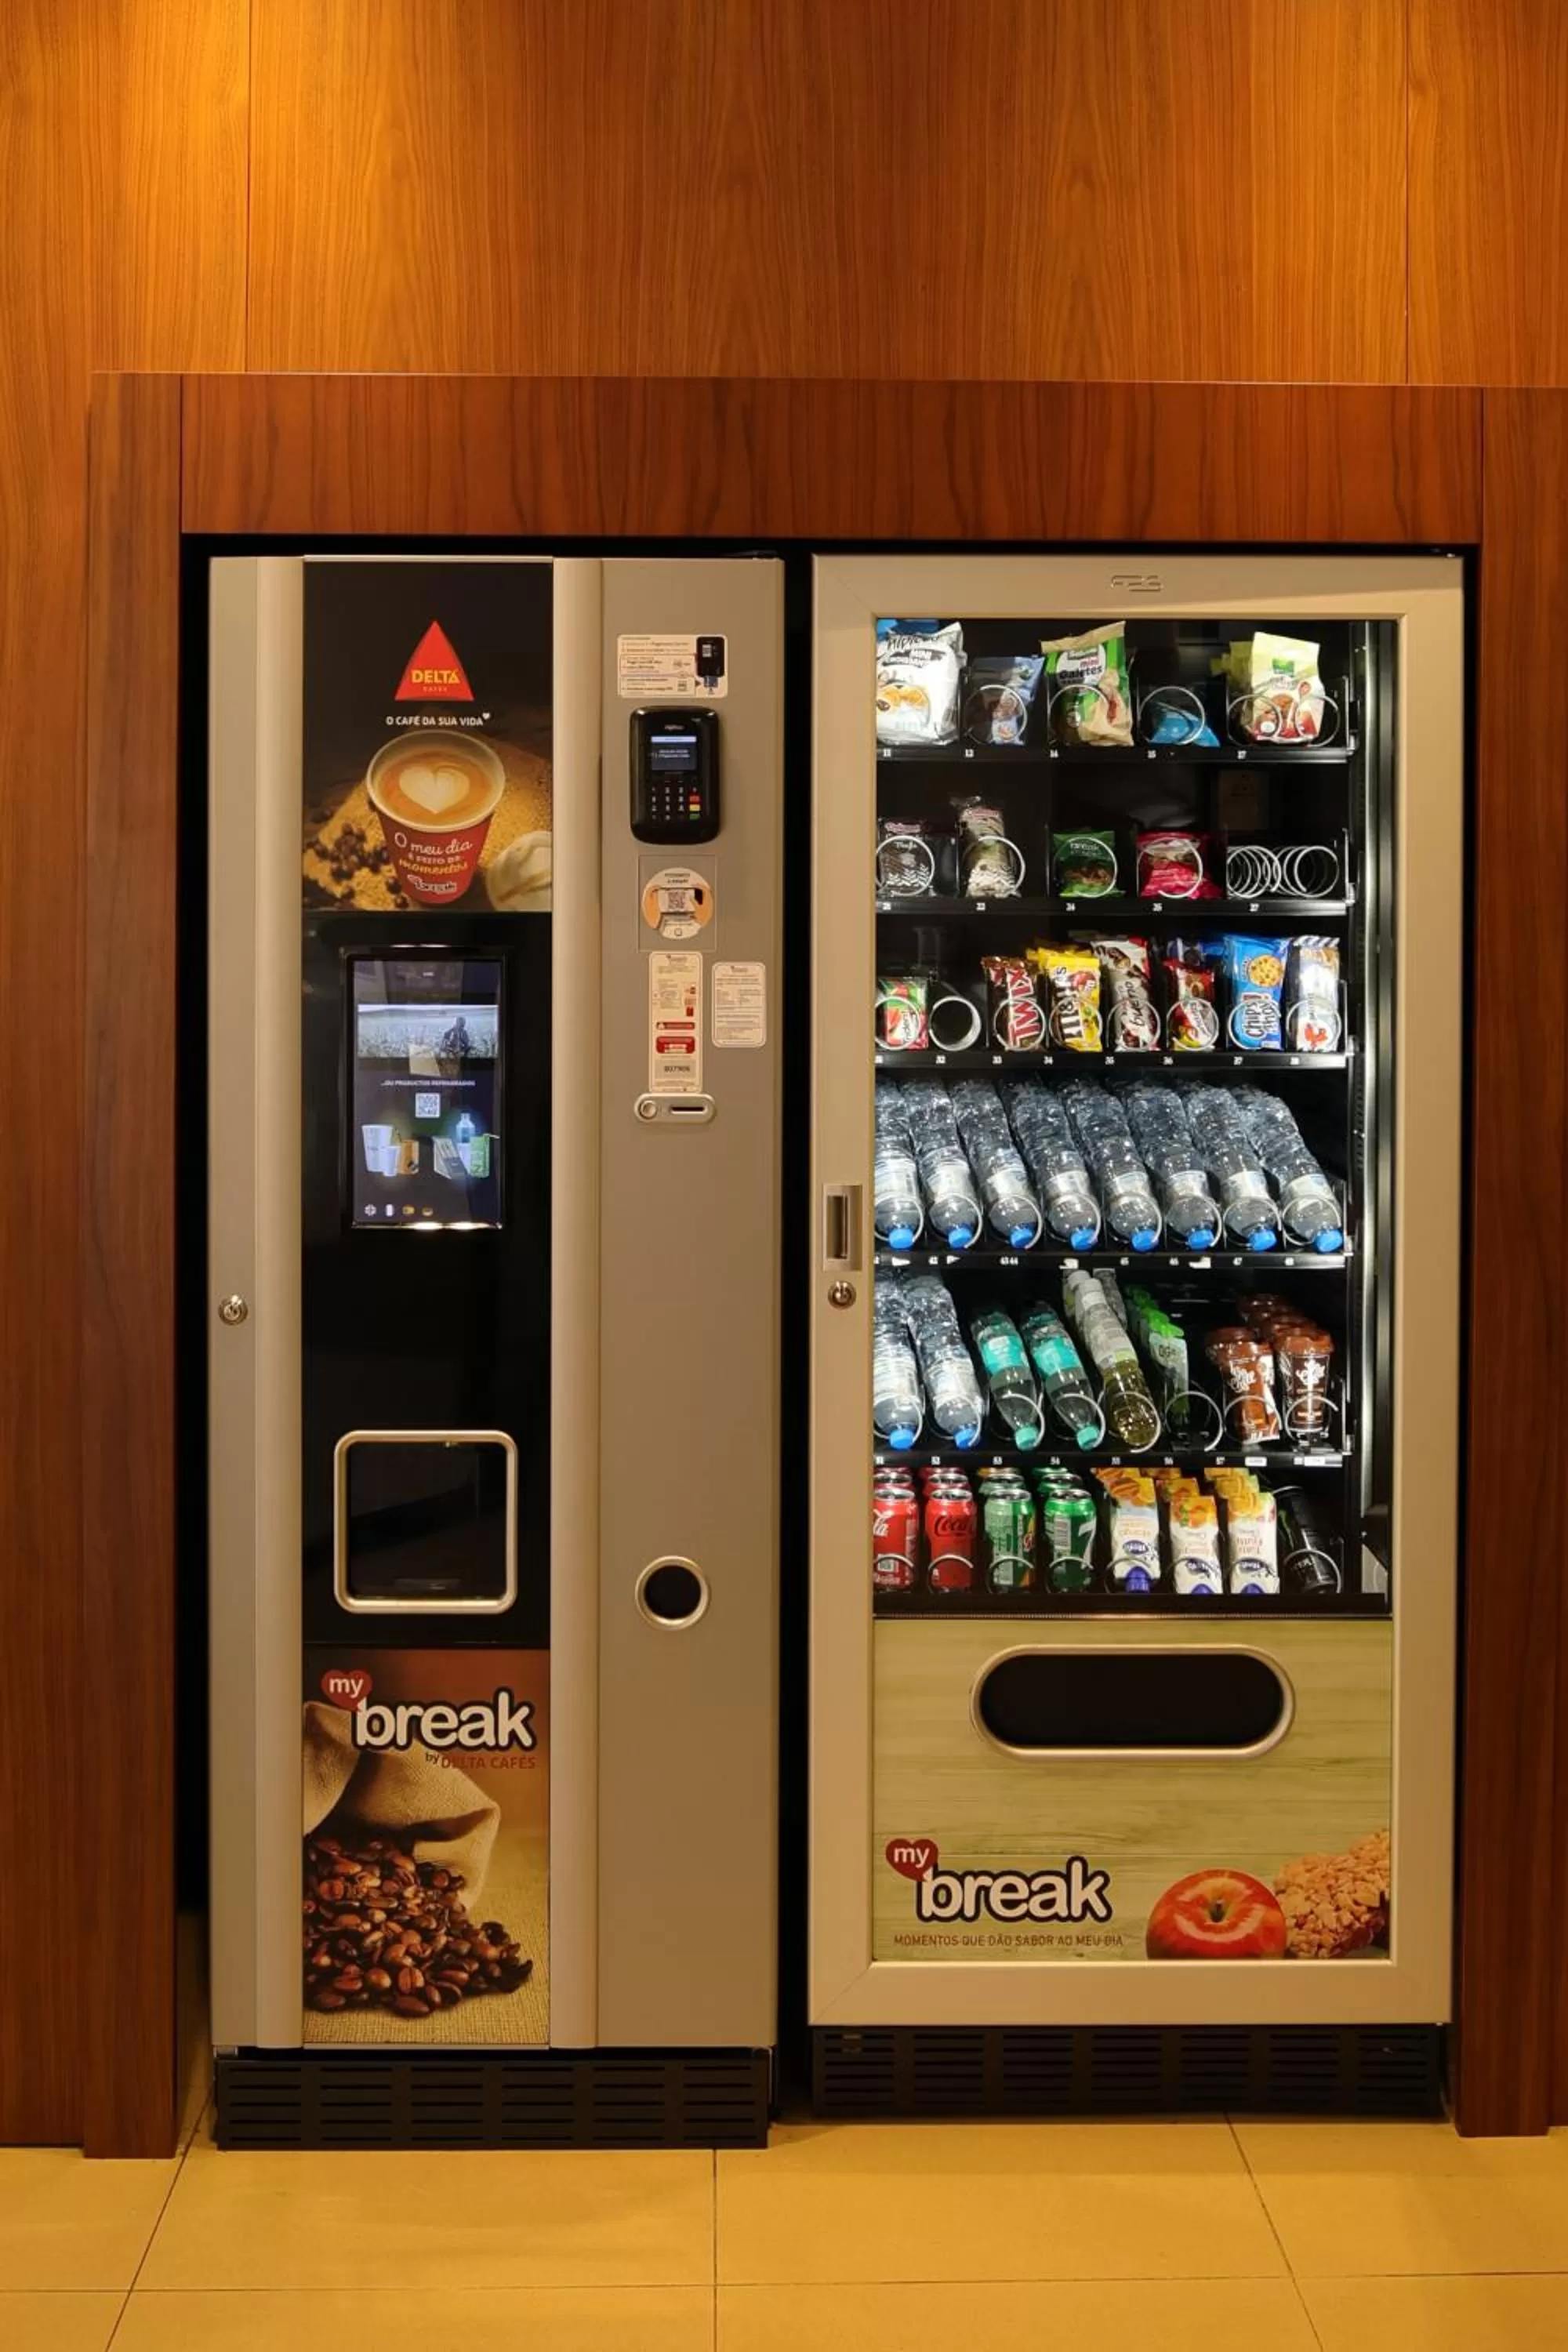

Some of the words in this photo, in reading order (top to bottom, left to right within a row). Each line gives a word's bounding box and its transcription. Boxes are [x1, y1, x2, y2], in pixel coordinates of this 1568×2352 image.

[412, 670, 460, 684] DELTA
[387, 717, 394, 725] O
[396, 715, 420, 725] CAFÉ
[423, 717, 436, 725] DA
[439, 717, 458, 725] SUA
[459, 717, 484, 726] VIDA
[394, 832, 407, 848] O
[411, 843, 443, 855] meu
[445, 838, 474, 855] dia
[329, 1677, 365, 1698] my
[356, 1691, 533, 1747] break
[425, 1753, 440, 1765] by
[441, 1757, 486, 1769] DELTA
[894, 1847, 930, 1867] my
[921, 1860, 1107, 1918] break
[894, 1934, 958, 1946] MOMENTOS
[962, 1934, 985, 1946] QUE
[989, 1933, 1012, 1946] DÃO
[1015, 1934, 1054, 1946] SABOR
[1058, 1934, 1073, 1946] AO
[1076, 1934, 1101, 1946] MEU
[1104, 1934, 1123, 1946] DIA
